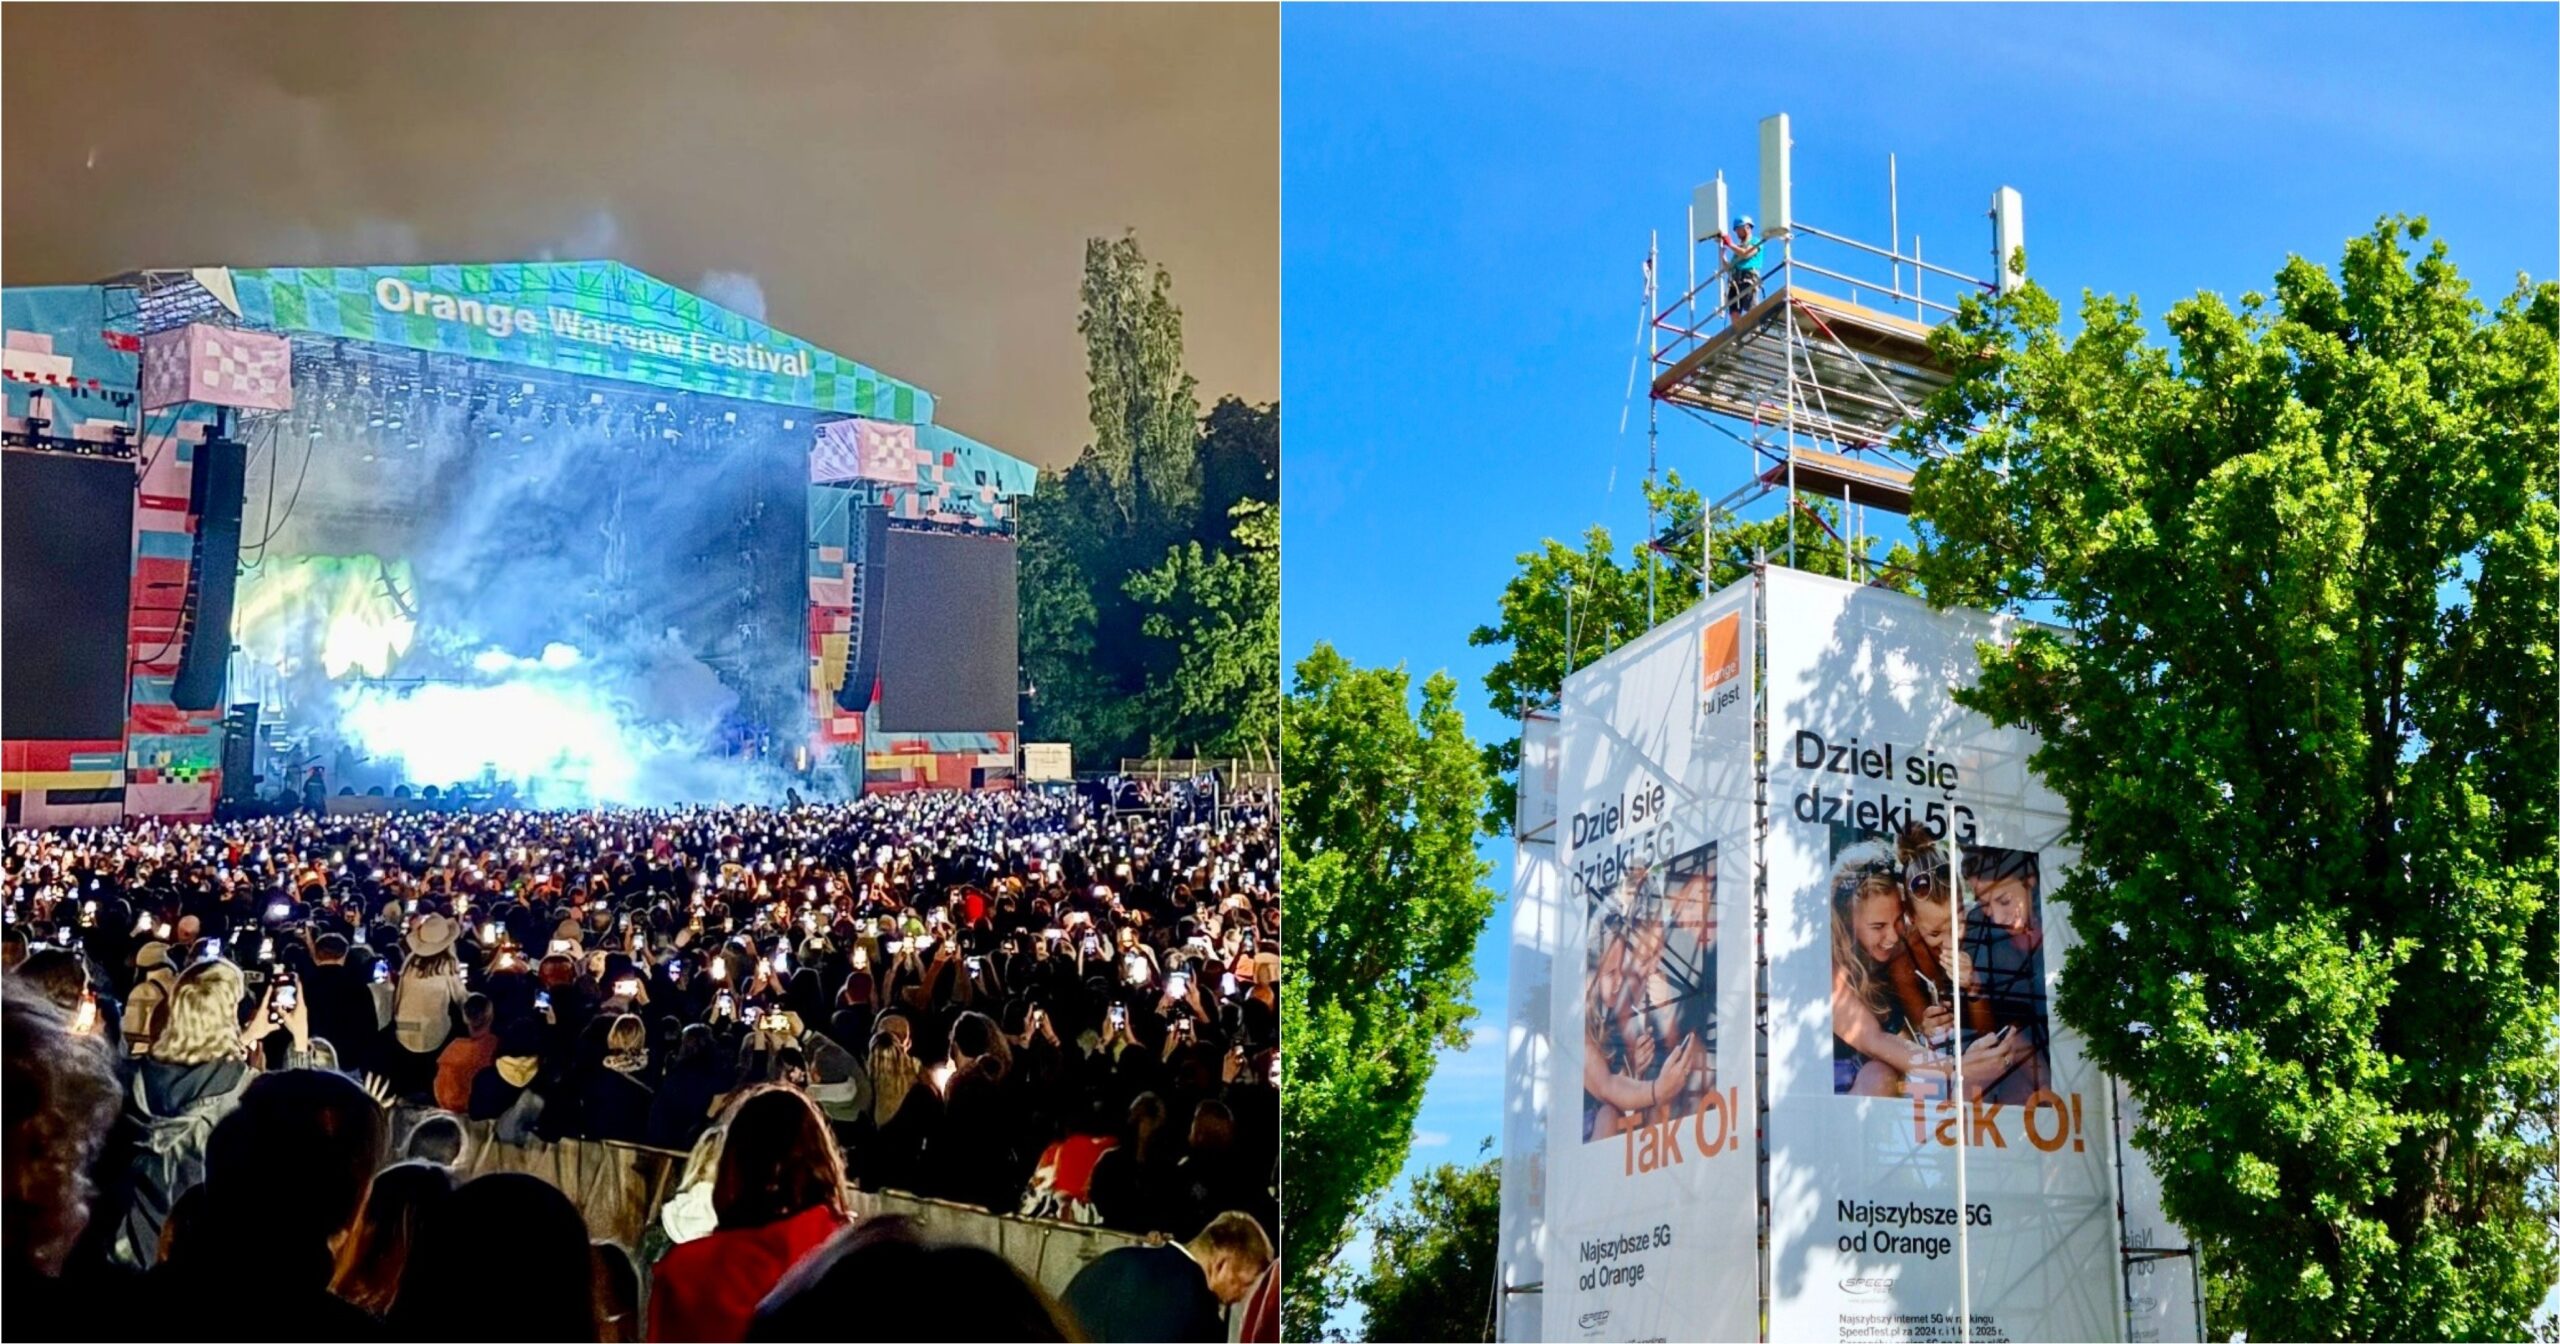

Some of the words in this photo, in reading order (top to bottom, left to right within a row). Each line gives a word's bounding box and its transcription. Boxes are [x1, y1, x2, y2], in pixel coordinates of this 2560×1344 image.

[375, 277, 537, 337] Orange
[548, 306, 683, 354] Warsaw
[690, 332, 807, 377] Festival
[1705, 661, 1737, 687] orange
[1703, 699, 1715, 716] tu
[1717, 684, 1740, 714] jest
[1796, 730, 1893, 780] Dziel
[1906, 750, 1958, 800] się
[1572, 793, 1624, 850] Dziel
[1632, 780, 1665, 823] się
[1925, 802, 1976, 845] 5G
[1643, 821, 1675, 868] 5G
[1617, 1103, 1684, 1177] Tak
[1695, 1086, 1738, 1158] O!
[1898, 1083, 2007, 1147] Tak
[2024, 1088, 2084, 1153] O!
[1838, 1200, 1958, 1228] Najszybsze
[1966, 1204, 1992, 1226] 5G
[1580, 1234, 1650, 1265] Najszybsze
[1653, 1224, 1671, 1249] 5G
[1838, 1231, 1866, 1252] od
[1874, 1230, 1951, 1260] Orange
[1579, 1269, 1595, 1291] od
[1599, 1264, 1645, 1287] Orange
[1845, 1278, 1894, 1287] SPEED
[1839, 1314, 1892, 1325] Najszybszy
[1894, 1314, 1928, 1324] internet
[1930, 1314, 1943, 1324] 5G
[1945, 1315, 1954, 1324] w
[1839, 1327, 1900, 1337] SpeedTest.pl
[1902, 1328, 1913, 1336] za
[1914, 1326, 1936, 1336] 2024
[1976, 1326, 1997, 1336] 2025
[1998, 1328, 2005, 1336] r.
